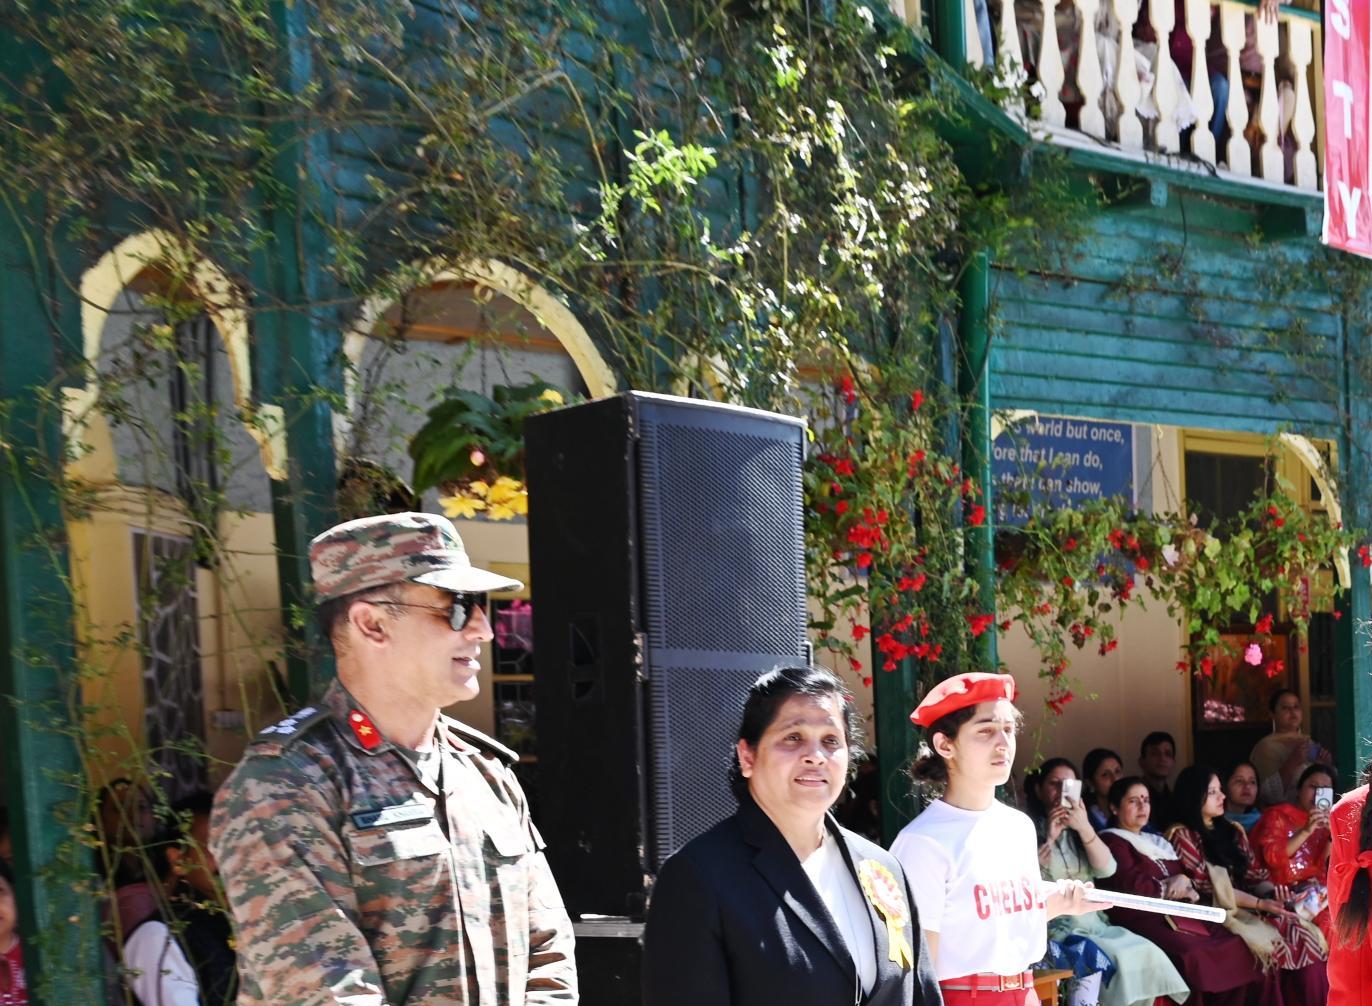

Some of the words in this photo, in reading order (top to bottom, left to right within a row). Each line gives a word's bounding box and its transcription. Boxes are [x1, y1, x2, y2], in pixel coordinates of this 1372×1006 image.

[1066, 421, 1088, 440] but
[1090, 428, 1125, 445] once,
[1083, 450, 1104, 470] do,
[1065, 476, 1103, 497] show,
